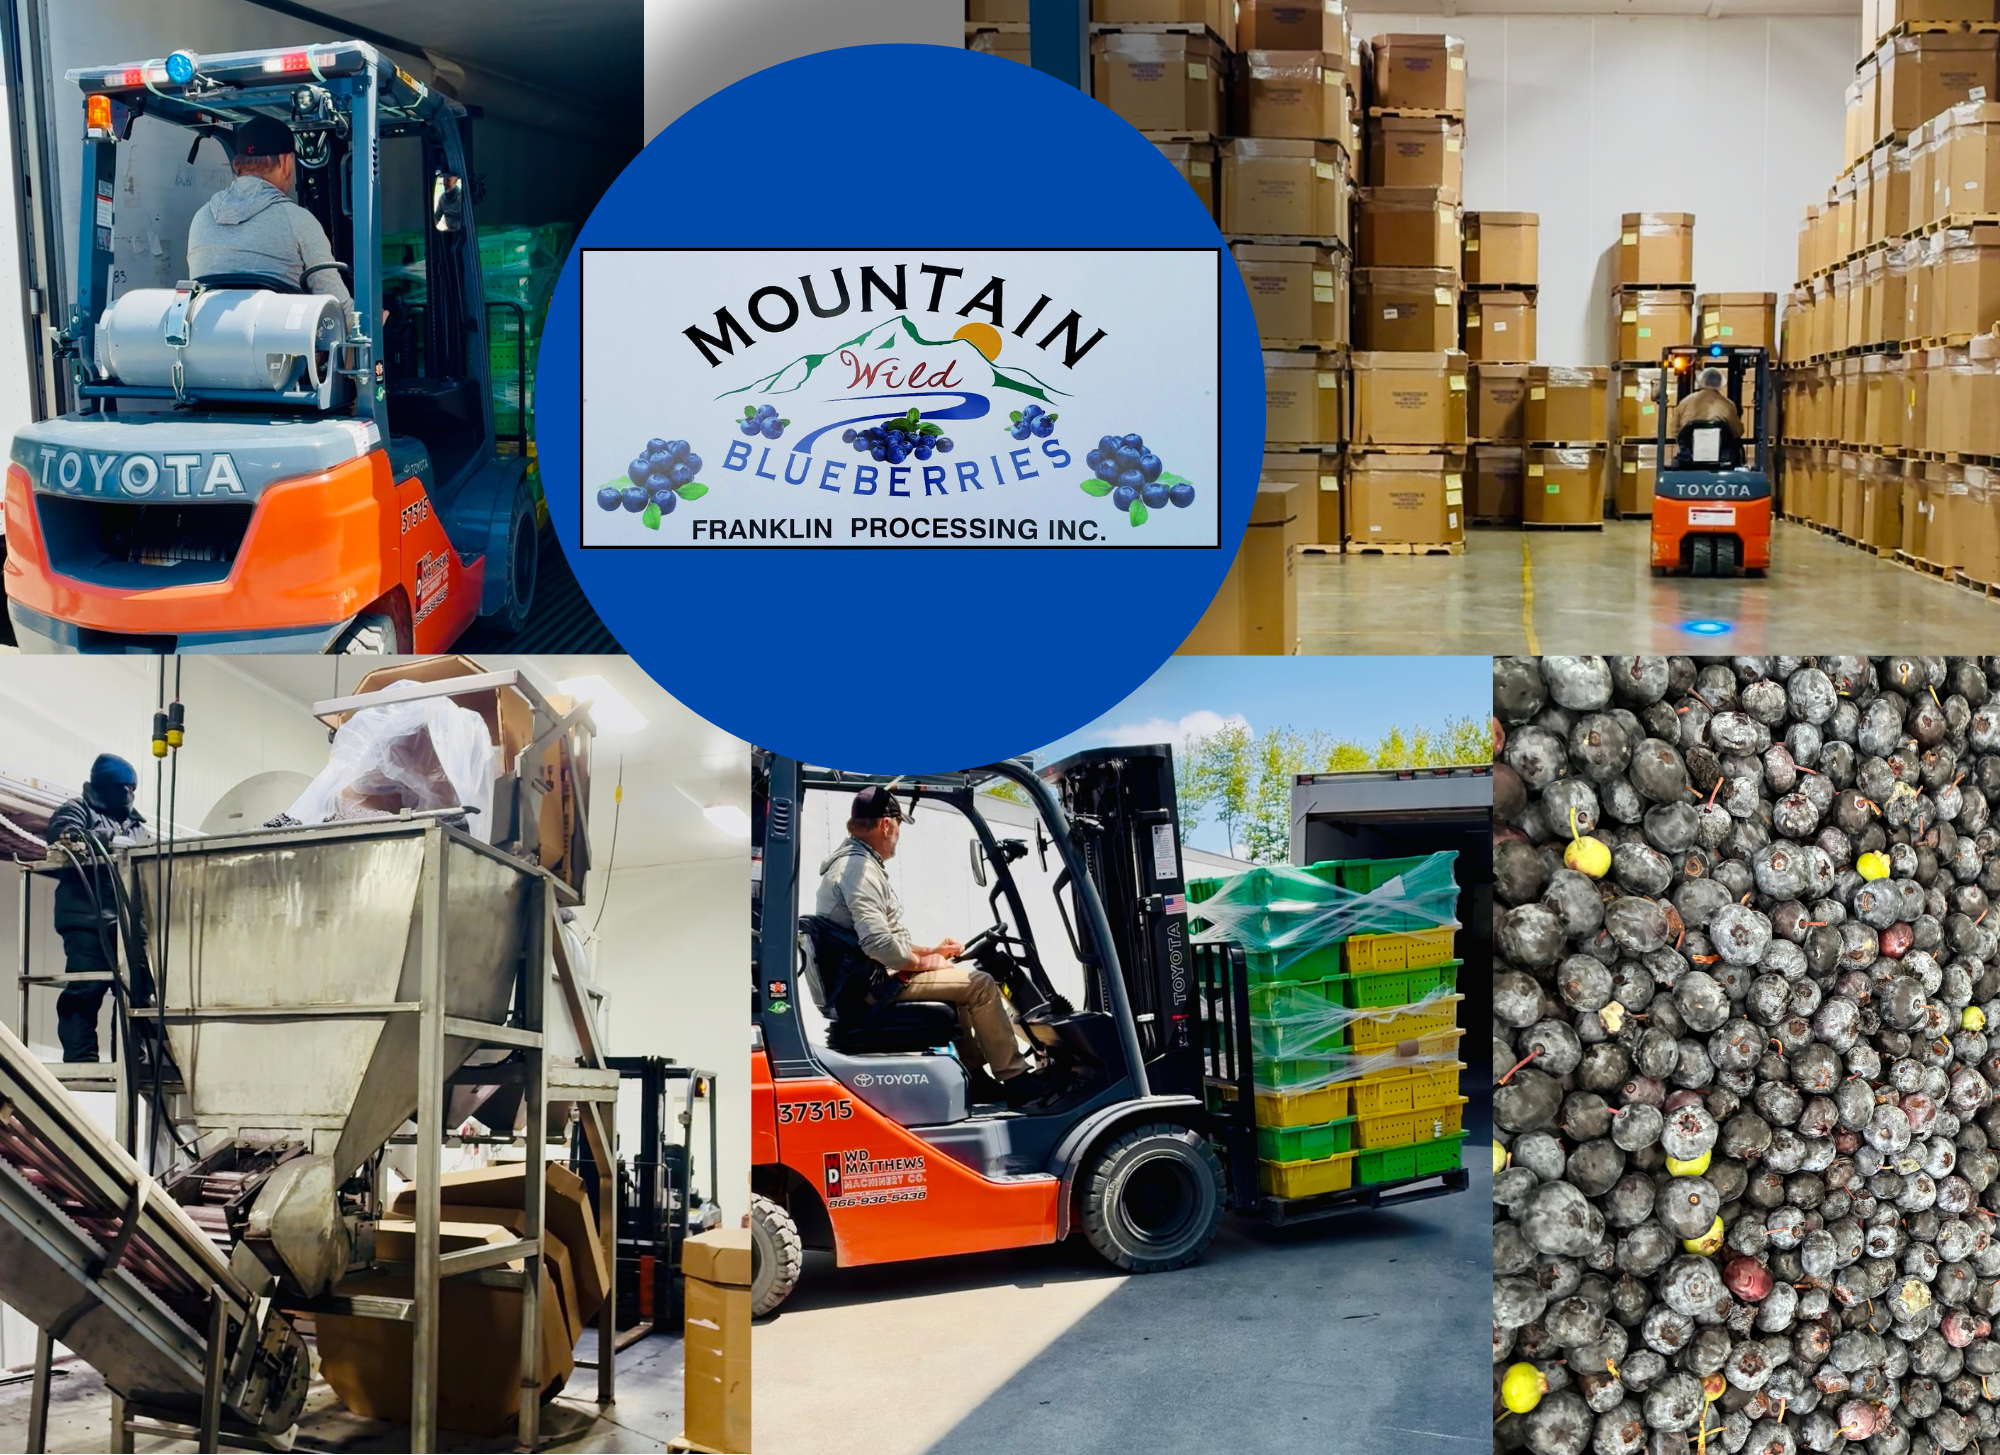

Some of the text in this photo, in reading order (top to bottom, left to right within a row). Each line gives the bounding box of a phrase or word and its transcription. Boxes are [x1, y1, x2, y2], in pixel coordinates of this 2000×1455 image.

[682, 263, 1108, 370] MOUNTAIN
[840, 349, 962, 389] Wild
[40, 447, 246, 497] TOYOTA
[410, 459, 428, 474] TOYOTA
[722, 438, 1072, 497] BLUEBERRIES
[1676, 484, 1751, 496] TOYOTA
[401, 496, 428, 534] 37315
[692, 517, 1107, 541] FRANKLIN PROCESSING INC.
[1167, 922, 1187, 1006] TOYOTA
[876, 1074, 930, 1085] TOYOTA
[778, 1100, 853, 1123] 37315
[844, 1150, 869, 1163] WD
[844, 1157, 925, 1175] MATTHEWS
[844, 1173, 927, 1190] MACHINERY CO.
[828, 1191, 927, 1209] 866-936-5438
